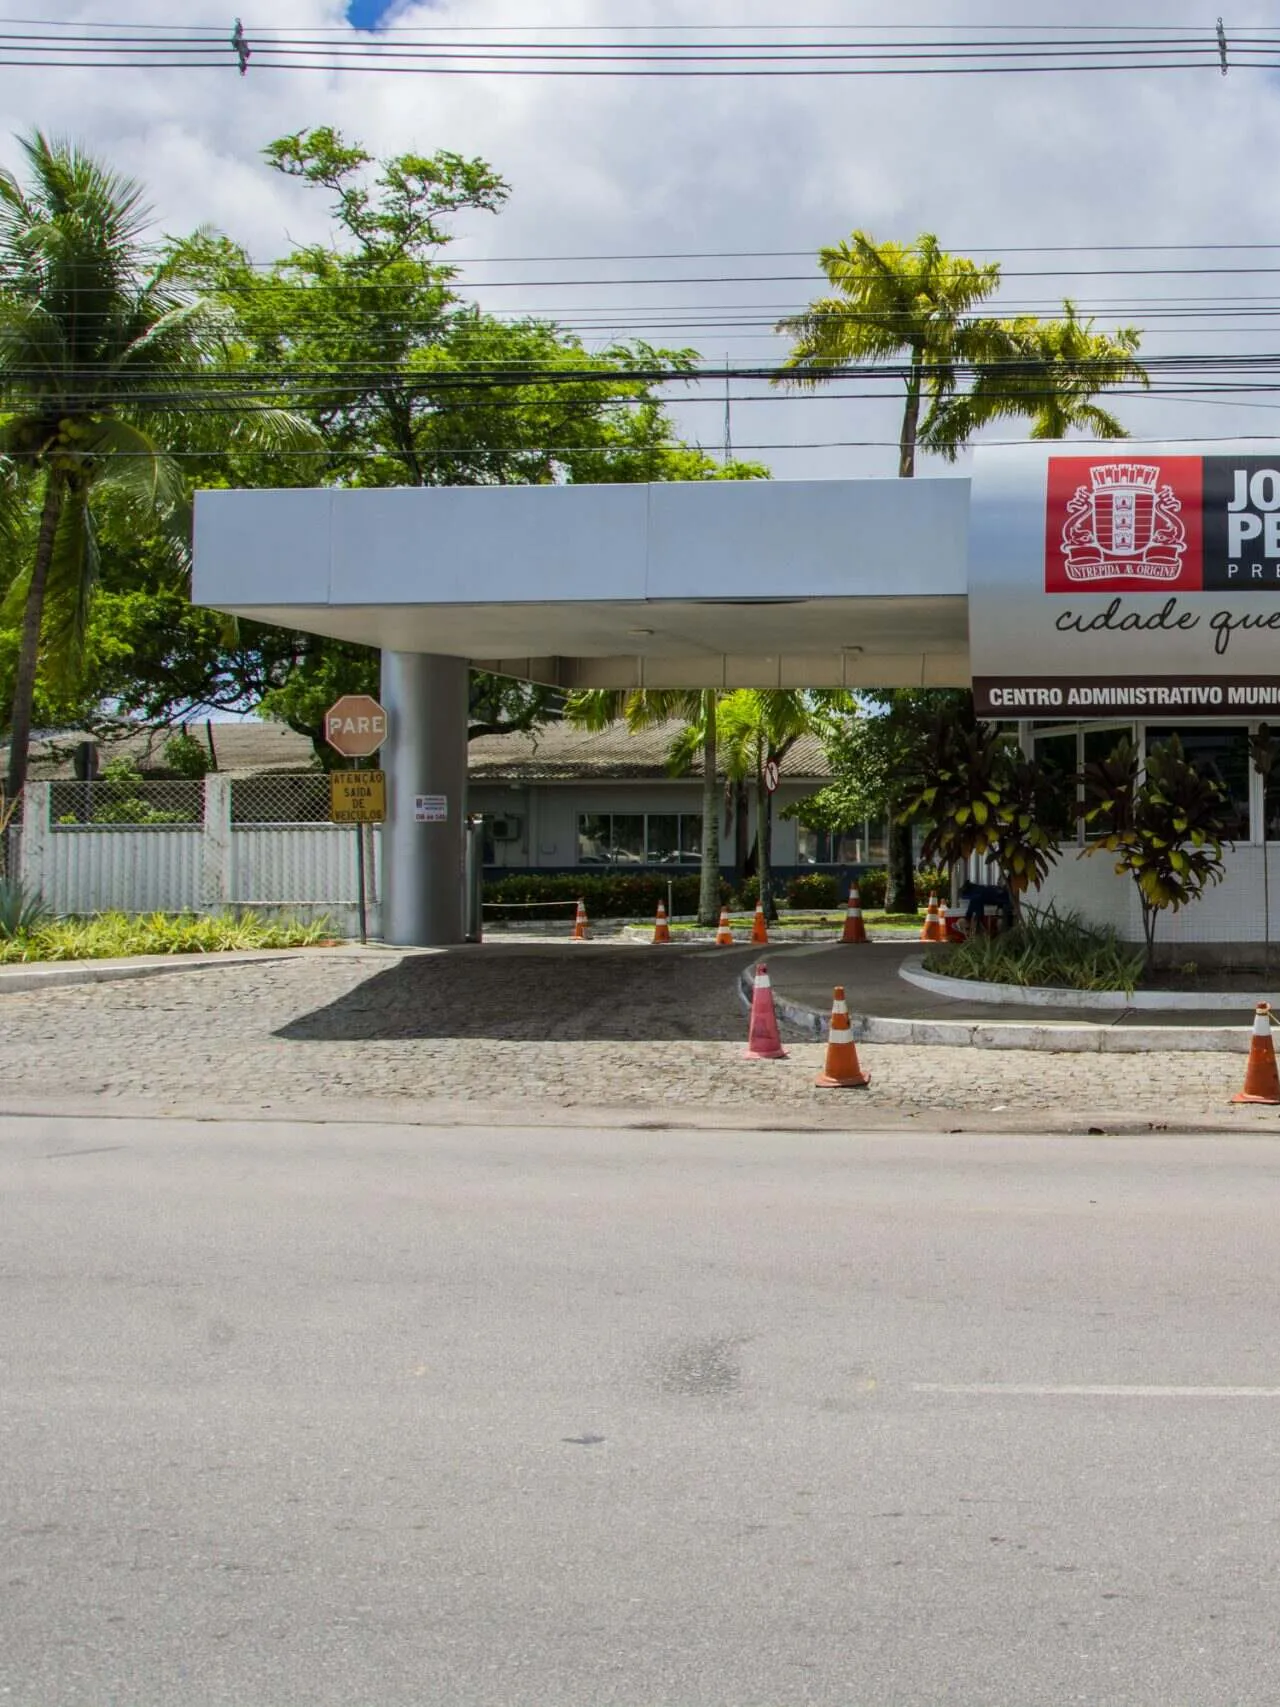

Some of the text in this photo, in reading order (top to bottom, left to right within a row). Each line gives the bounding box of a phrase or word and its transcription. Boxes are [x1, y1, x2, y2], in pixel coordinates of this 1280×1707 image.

[1070, 564, 1120, 578] INTREPIDA
[1136, 564, 1178, 577] ORIGINE
[1055, 597, 1200, 632] cidade
[989, 688, 1063, 706] CENTRO
[1067, 687, 1223, 705] ADMINISTRATIVO
[330, 716, 384, 735] PARE
[334, 771, 383, 785] ATENÇÃO
[352, 798, 366, 809] DE
